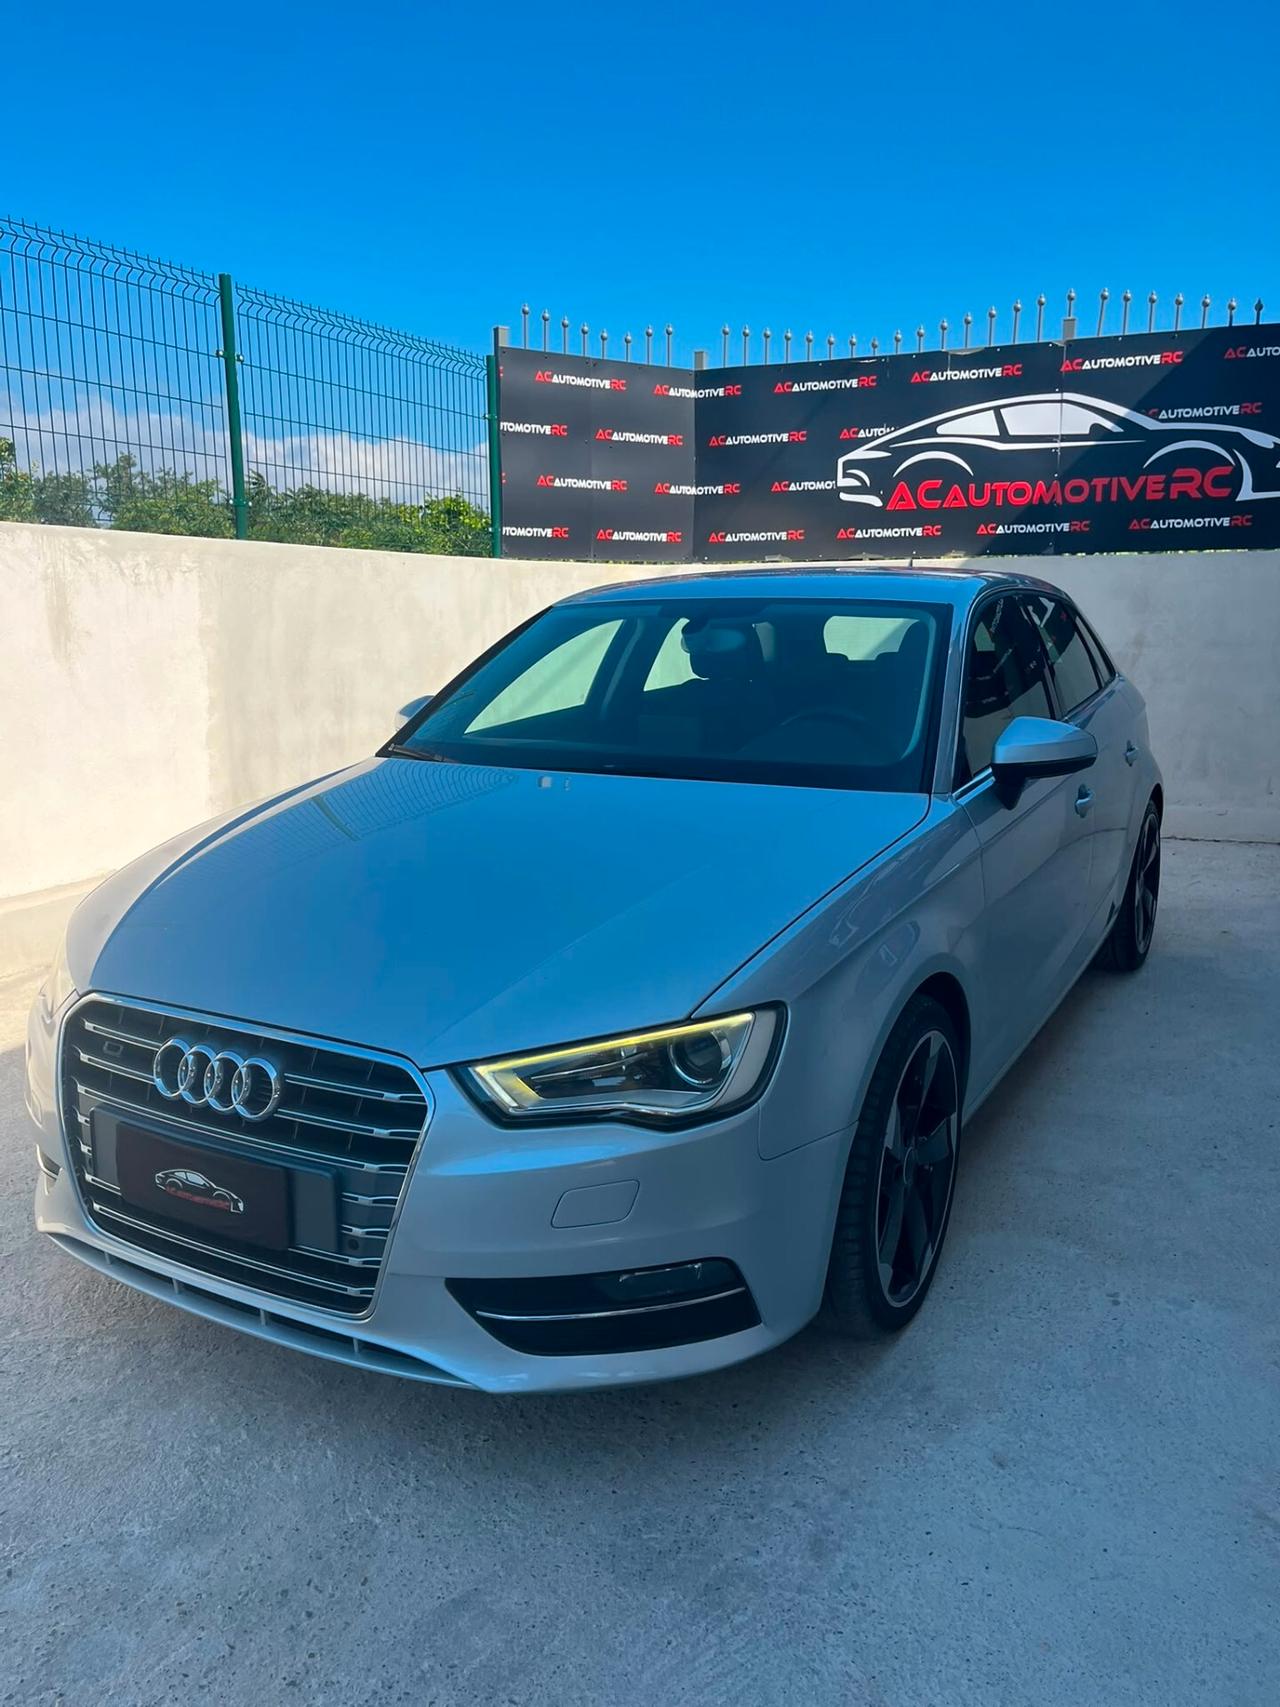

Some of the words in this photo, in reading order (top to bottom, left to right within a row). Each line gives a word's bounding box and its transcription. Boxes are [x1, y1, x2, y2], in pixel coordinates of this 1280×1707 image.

[1060, 351, 1183, 372] ACAUTOMOTIVERC
[535, 370, 627, 390] ACAUTOMOTIVERC
[911, 363, 1023, 384] ACAUTOMOTIVERC
[653, 384, 742, 398] ACAUTOMOTIVERC
[773, 376, 877, 394] ACAUTOMOTIVERC
[1147, 402, 1262, 419] CAUTOMOTIVERC
[596, 429, 683, 446] ACAUTOMOTIVERC
[709, 431, 807, 446] ACAUTOMOTIVERC
[536, 475, 629, 491] ACAUTOMOTIVERC
[886, 466, 1233, 511] ACAUTOMOTIVERC
[976, 521, 1091, 537] ACAUTOMOTIVERC
[1129, 515, 1253, 530] ACAUTOMOTIVERC
[597, 528, 682, 543] ACAUTOMOTIVERC
[708, 529, 806, 543] ACAUTOMOTIVERC
[836, 525, 942, 539] ACAUTOMOTIVERC
